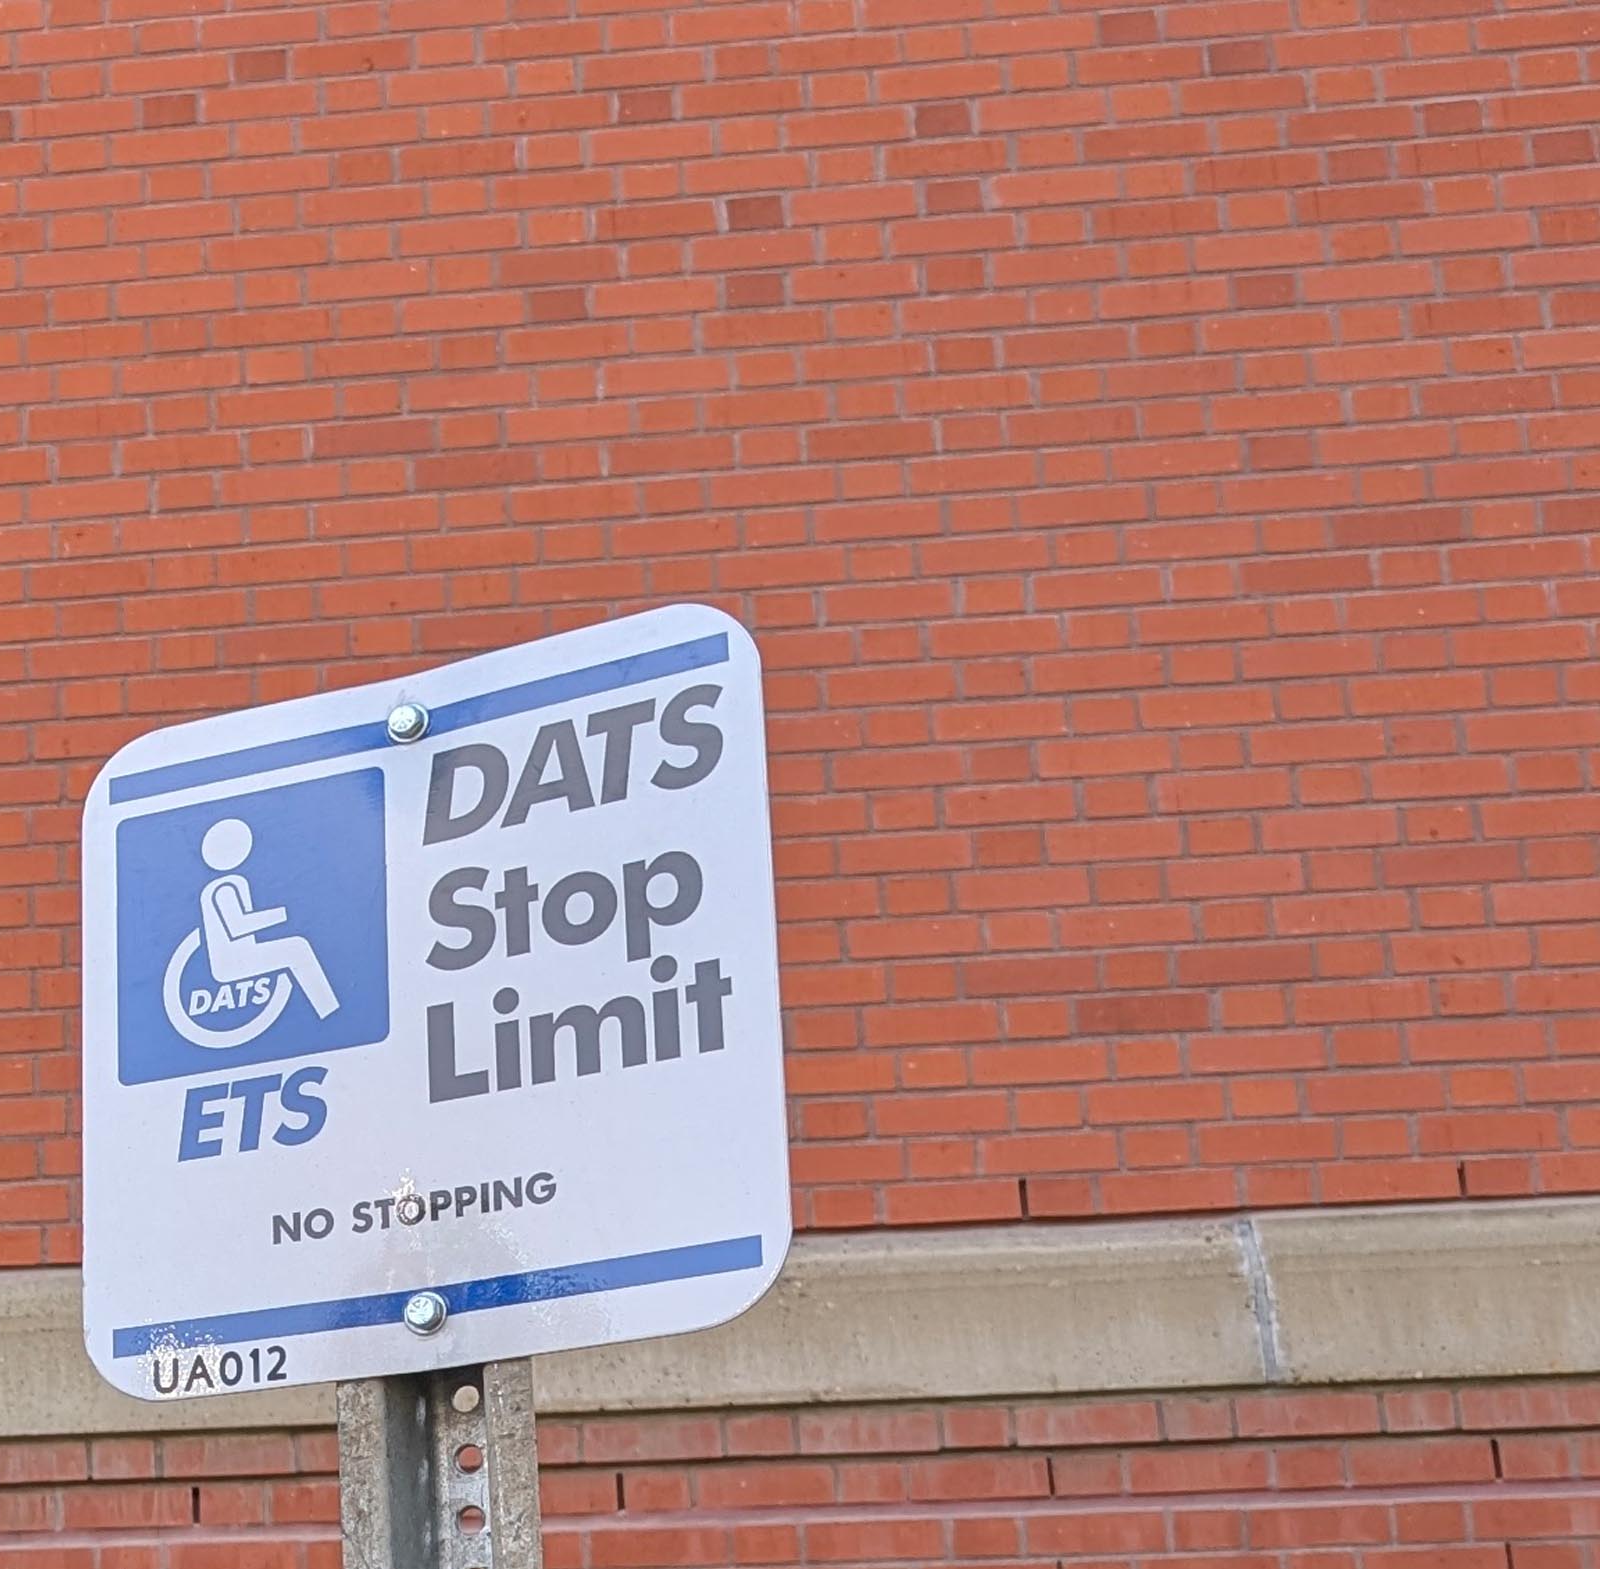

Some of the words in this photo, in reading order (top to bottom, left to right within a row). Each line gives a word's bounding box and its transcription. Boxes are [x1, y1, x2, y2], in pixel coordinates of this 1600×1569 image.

[422, 684, 724, 846] DATS
[426, 851, 703, 971] Stop
[188, 977, 273, 1017] DATS
[427, 955, 732, 1105] Limit
[177, 1066, 329, 1163] ETS
[271, 1207, 334, 1246] NO
[351, 1171, 558, 1234] STOPPING
[153, 1345, 287, 1394] UA012
